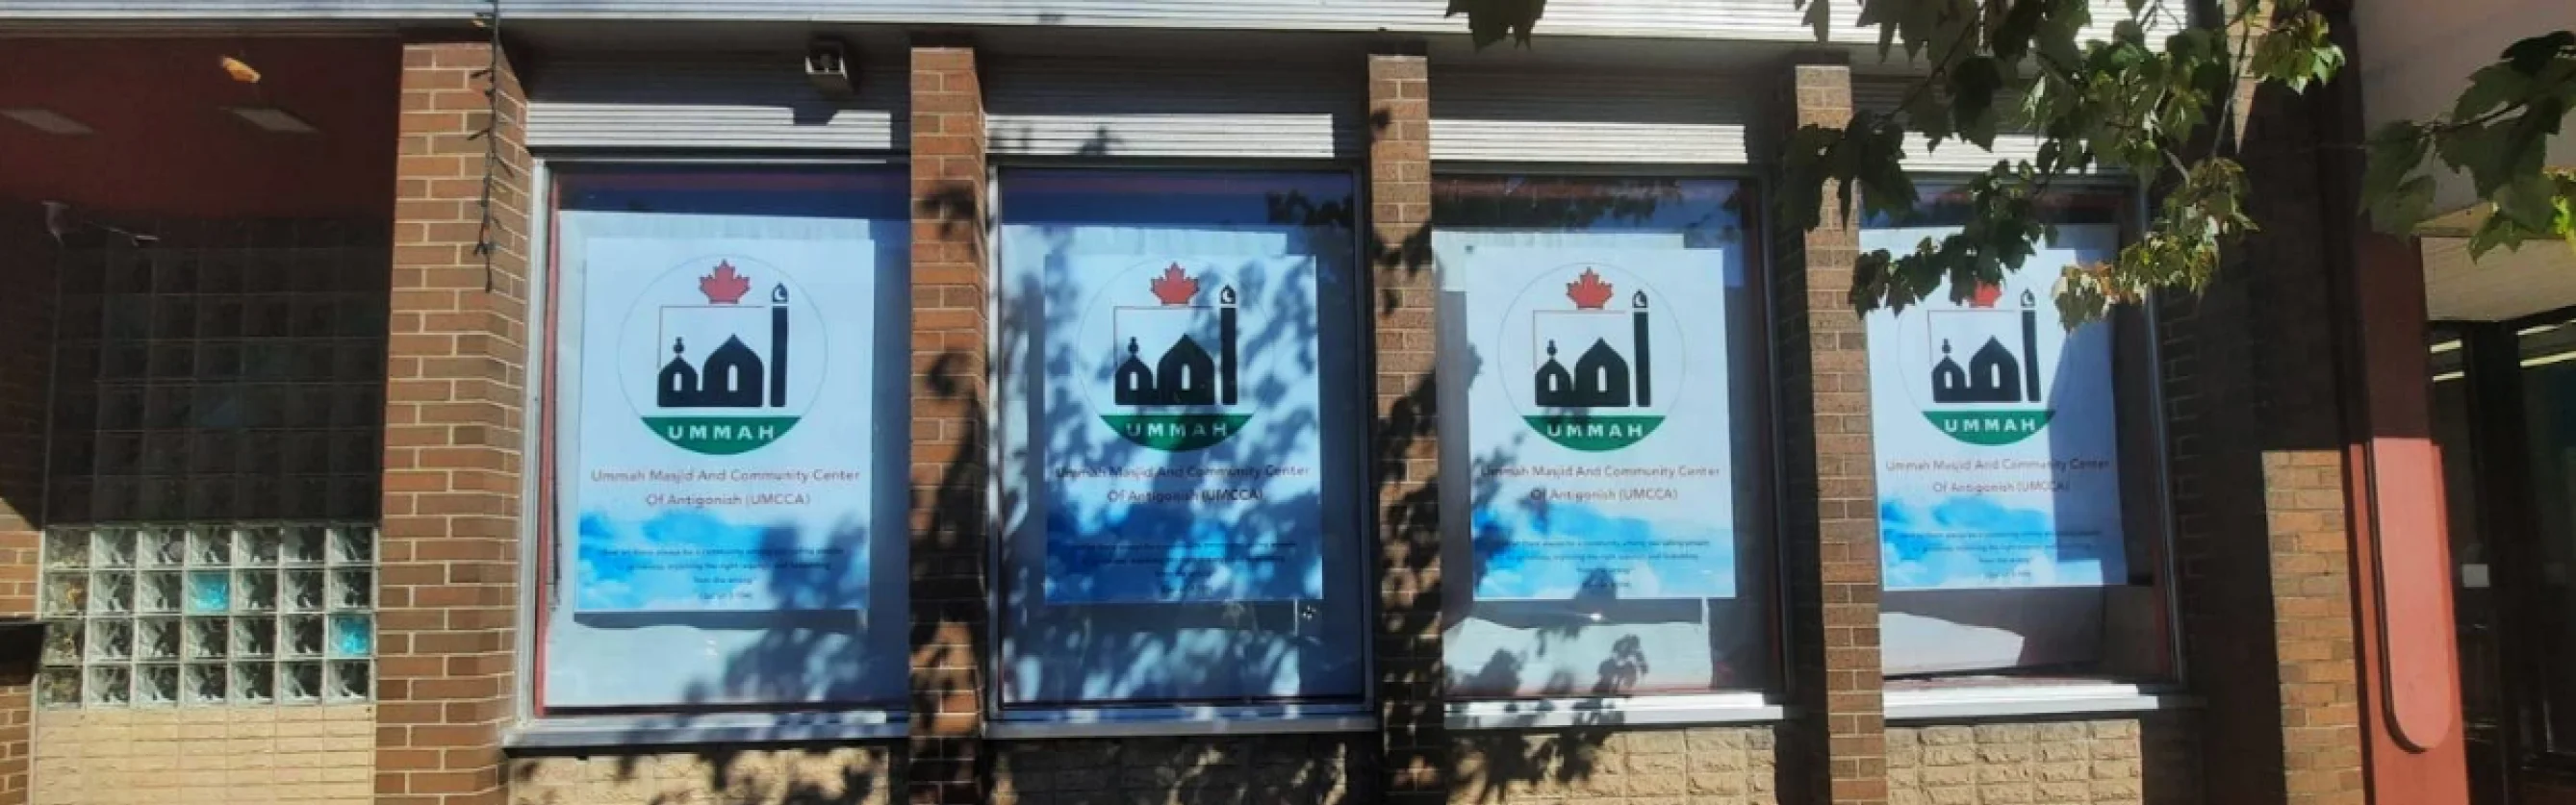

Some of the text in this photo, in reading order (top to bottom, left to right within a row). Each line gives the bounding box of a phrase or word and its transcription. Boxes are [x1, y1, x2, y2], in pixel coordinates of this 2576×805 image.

[667, 425, 775, 440] UMMAH
[1125, 422, 1228, 438] UMMAH
[1546, 422, 1644, 438] UMMAH
[1944, 418, 2036, 433] UMMAH
[591, 468, 860, 484] Ummah Masjid And Community Center
[1481, 465, 1721, 480] Ummah Masjid And Community Center
[646, 492, 811, 508] Of Antigonish (UMCCA)
[1530, 488, 1678, 504] Of Antigonish (UMCCA)
